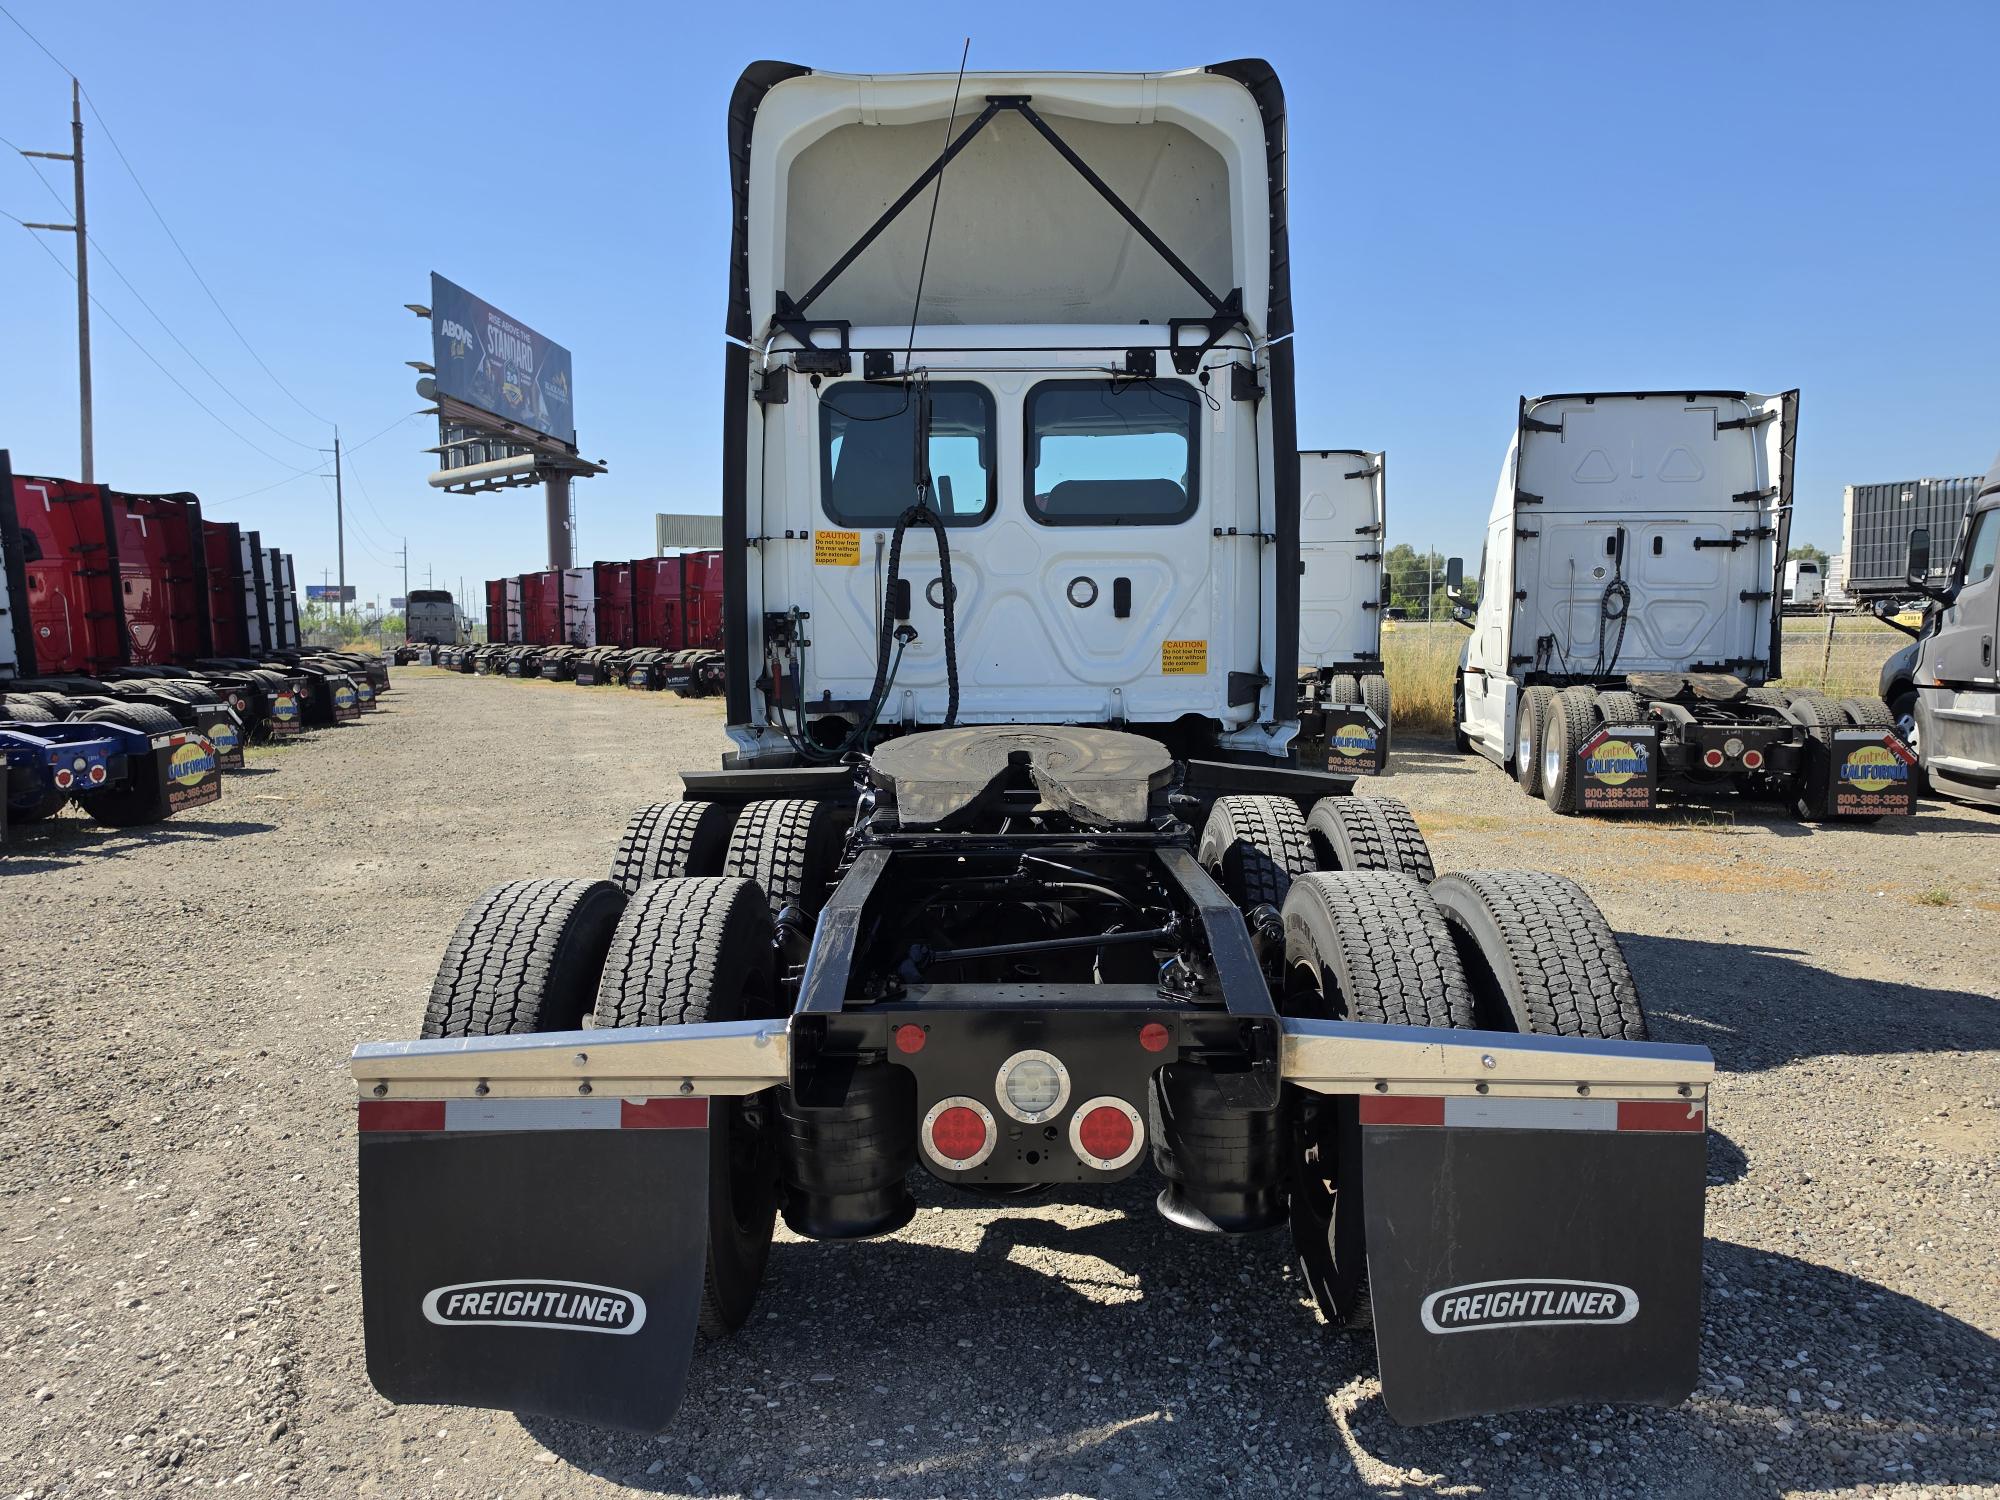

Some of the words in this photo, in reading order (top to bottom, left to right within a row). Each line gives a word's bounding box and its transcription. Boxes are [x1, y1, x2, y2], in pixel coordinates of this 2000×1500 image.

[441, 319, 473, 350] ABOVE
[502, 320, 519, 337] ABOVE
[520, 330, 531, 344] THE
[487, 324, 533, 373] STANDARD
[820, 531, 856, 540] CAUTION
[1331, 735, 1377, 750] CALIFORNIA
[1592, 740, 1632, 759] Central
[1847, 746, 1892, 765] Central
[167, 755, 216, 780] CALIFORNIA
[1586, 758, 1648, 773] CALIFORNIA
[1840, 763, 1908, 780] CALIFORNIA
[1584, 787, 1649, 798] 800-366-3263
[1837, 794, 1909, 805] 800-366-3263
[1585, 799, 1649, 808] WTruckSales.net
[1837, 805, 1908, 815] WTruckSales.net
[446, 1291, 627, 1324] FREIGHTLINER
[1440, 1290, 1617, 1323] FREIGHTLINER
